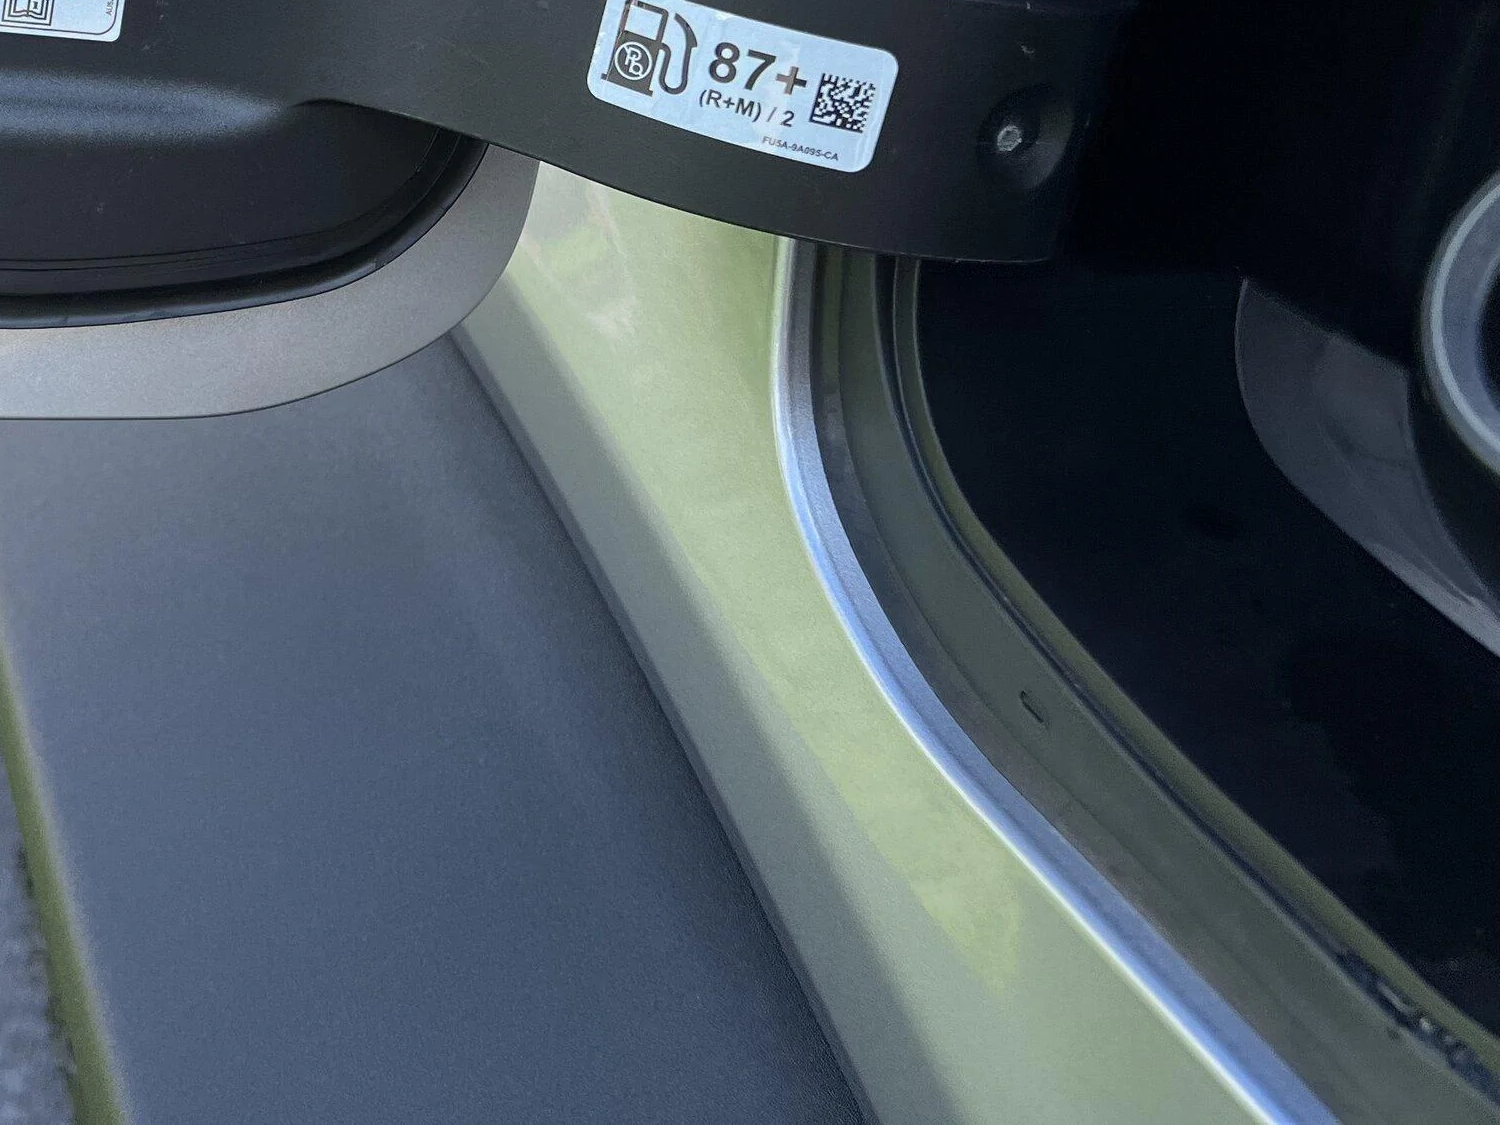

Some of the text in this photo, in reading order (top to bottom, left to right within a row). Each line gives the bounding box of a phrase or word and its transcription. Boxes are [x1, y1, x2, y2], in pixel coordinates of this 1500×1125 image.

[708, 41, 807, 95] 87+
[699, 88, 761, 123] (R+M)
[779, 110, 795, 128] 2
